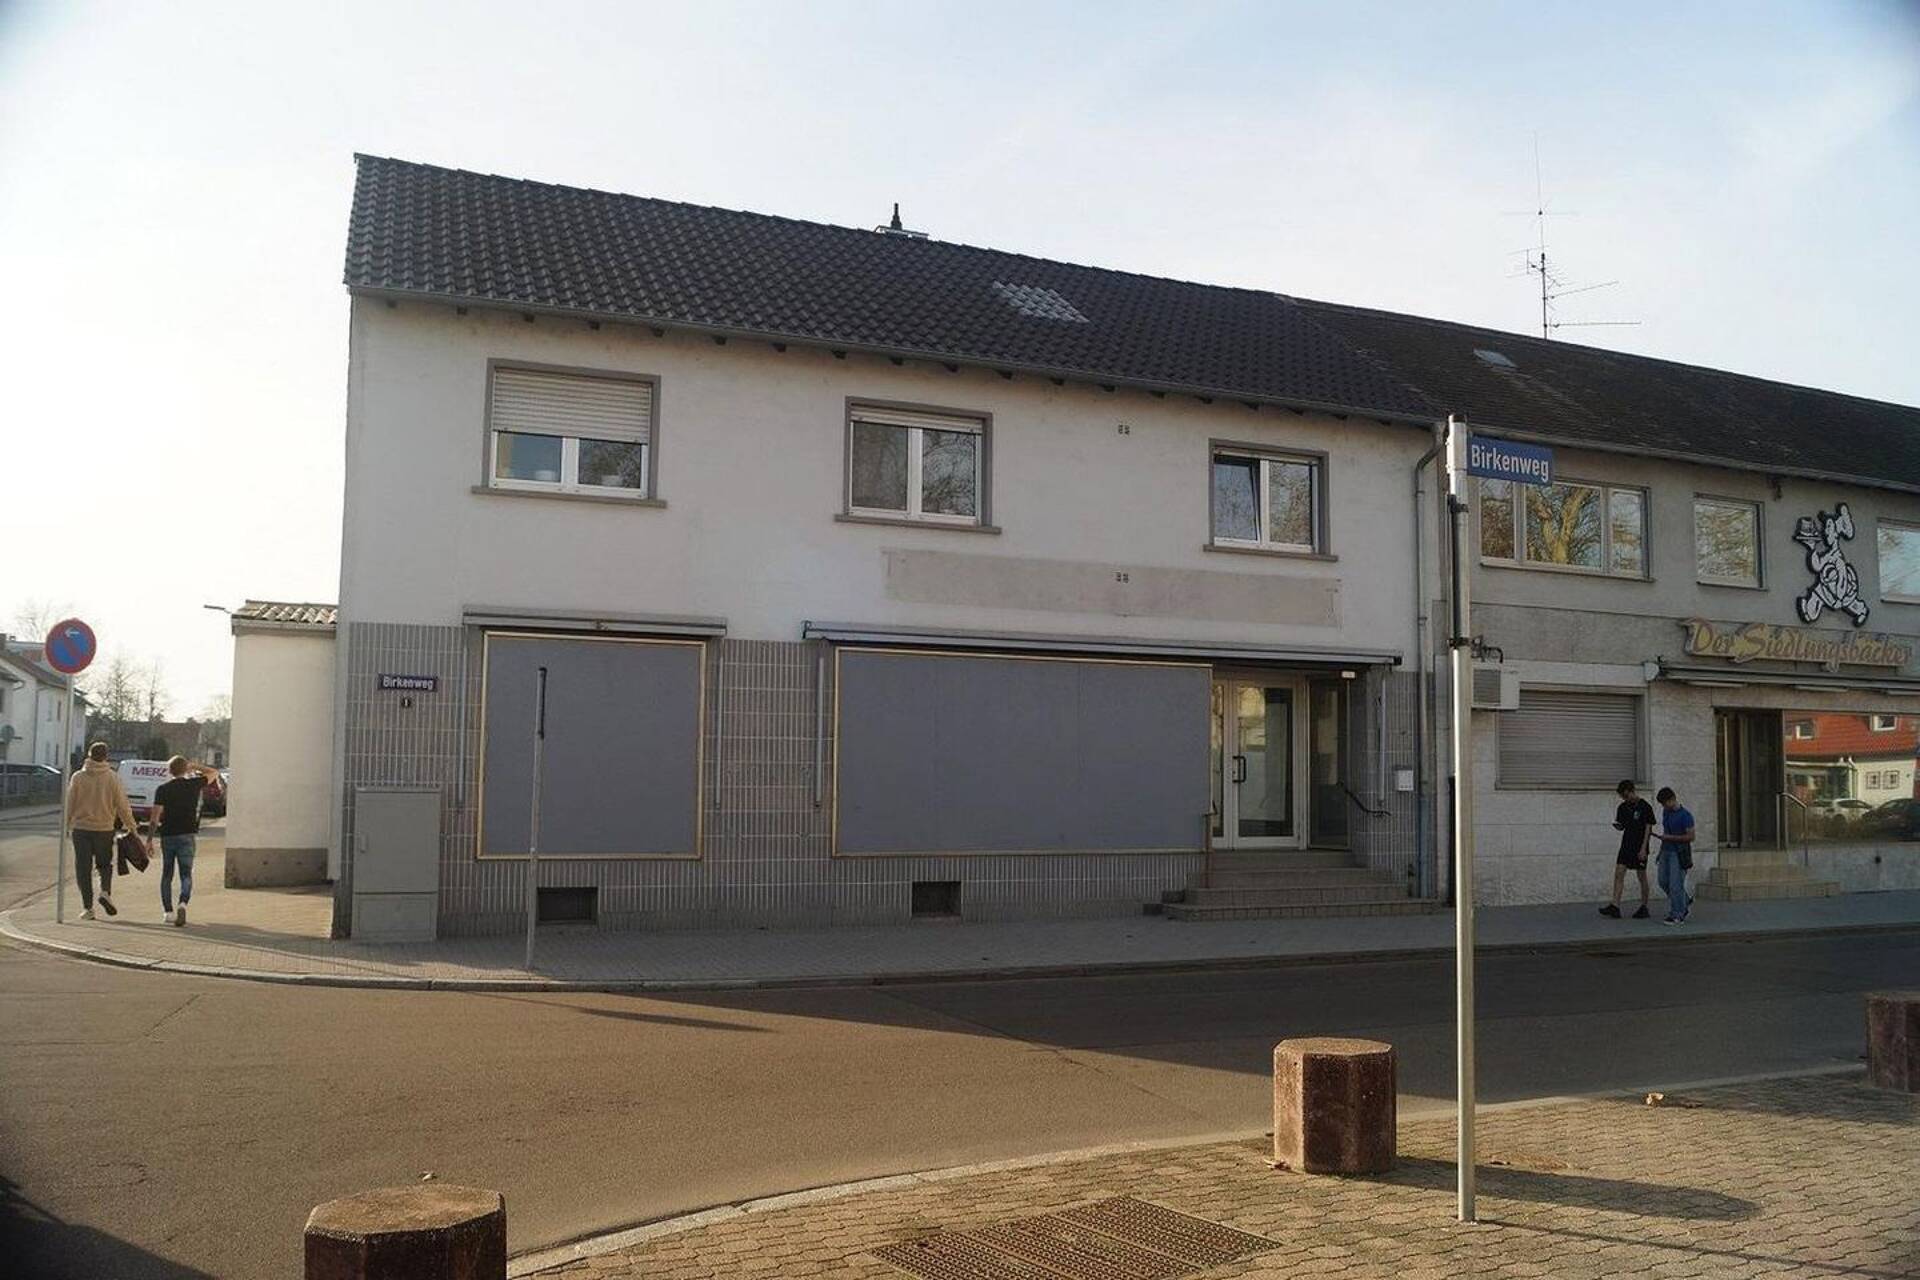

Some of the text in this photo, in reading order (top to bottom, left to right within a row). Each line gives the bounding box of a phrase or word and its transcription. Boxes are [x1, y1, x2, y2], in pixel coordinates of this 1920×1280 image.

[1471, 444, 1549, 482] Birkenweg
[1684, 617, 1736, 655] Der
[382, 675, 434, 691] Birkenweg
